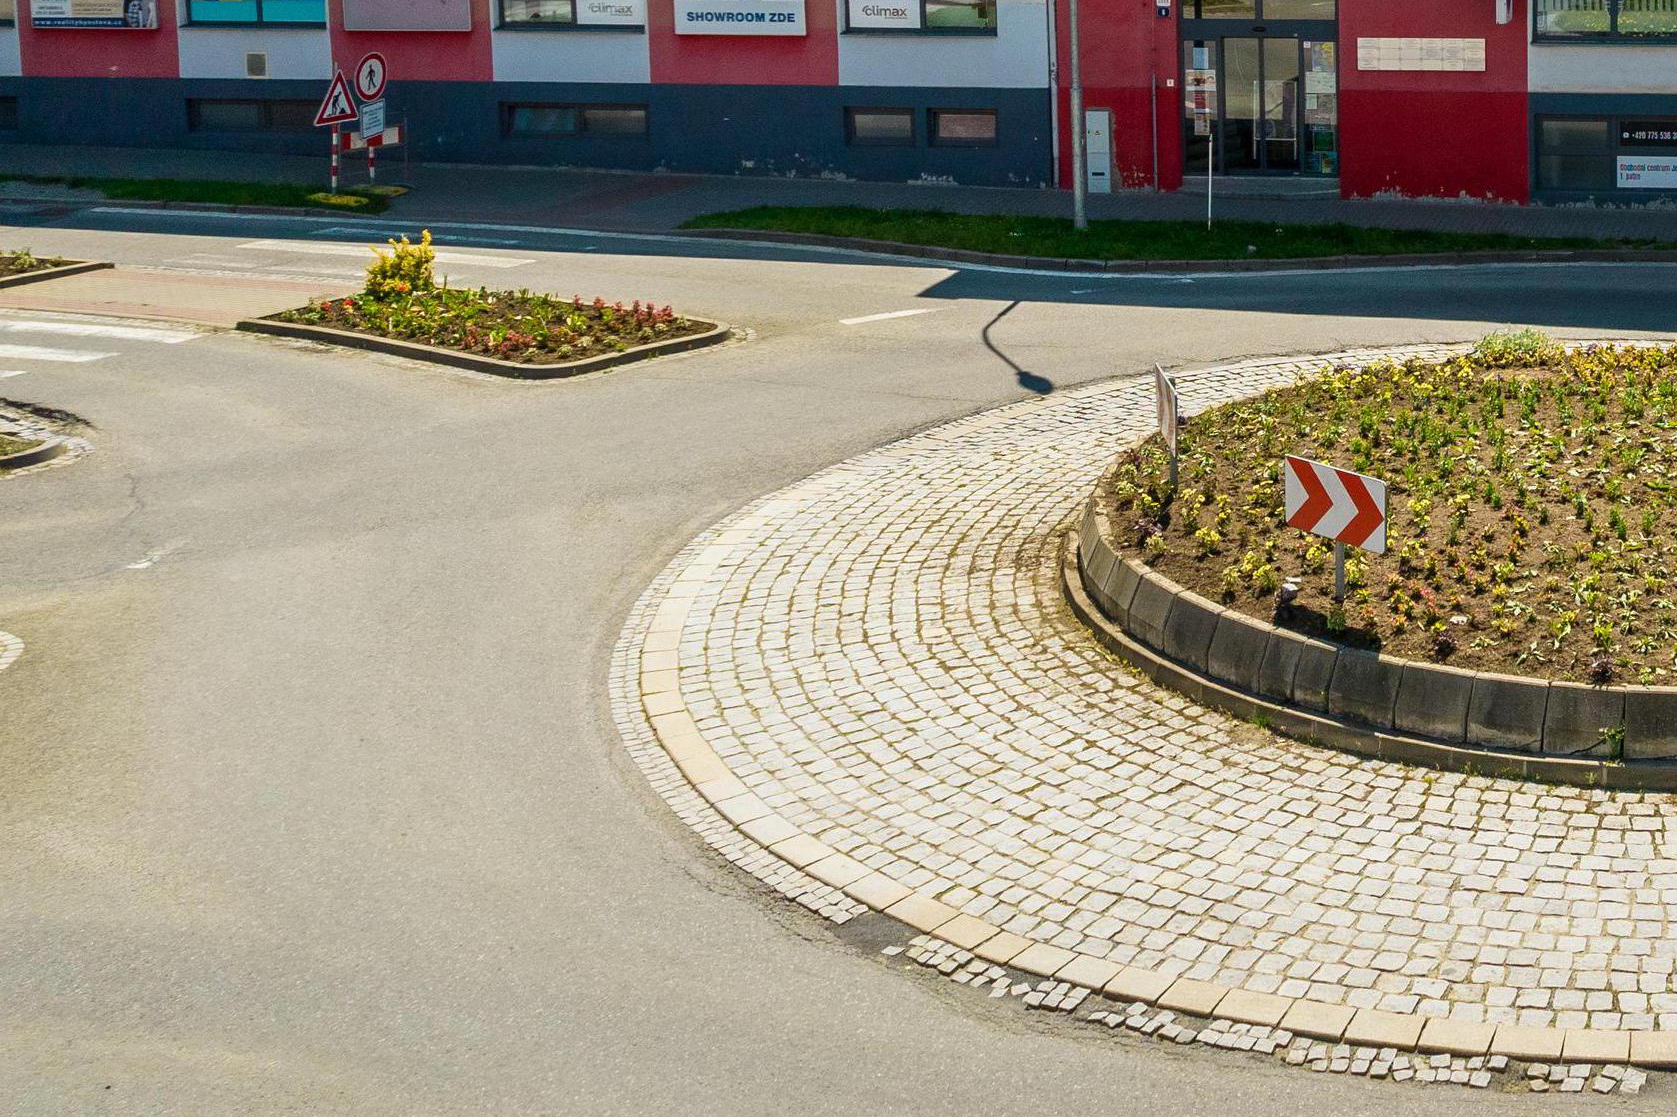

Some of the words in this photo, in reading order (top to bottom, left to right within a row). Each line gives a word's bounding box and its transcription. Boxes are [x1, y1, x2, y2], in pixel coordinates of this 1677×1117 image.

[591, 4, 633, 14] climax
[865, 5, 907, 16] climax
[687, 11, 765, 22] SHOWROOM
[769, 13, 795, 22] ZDE
